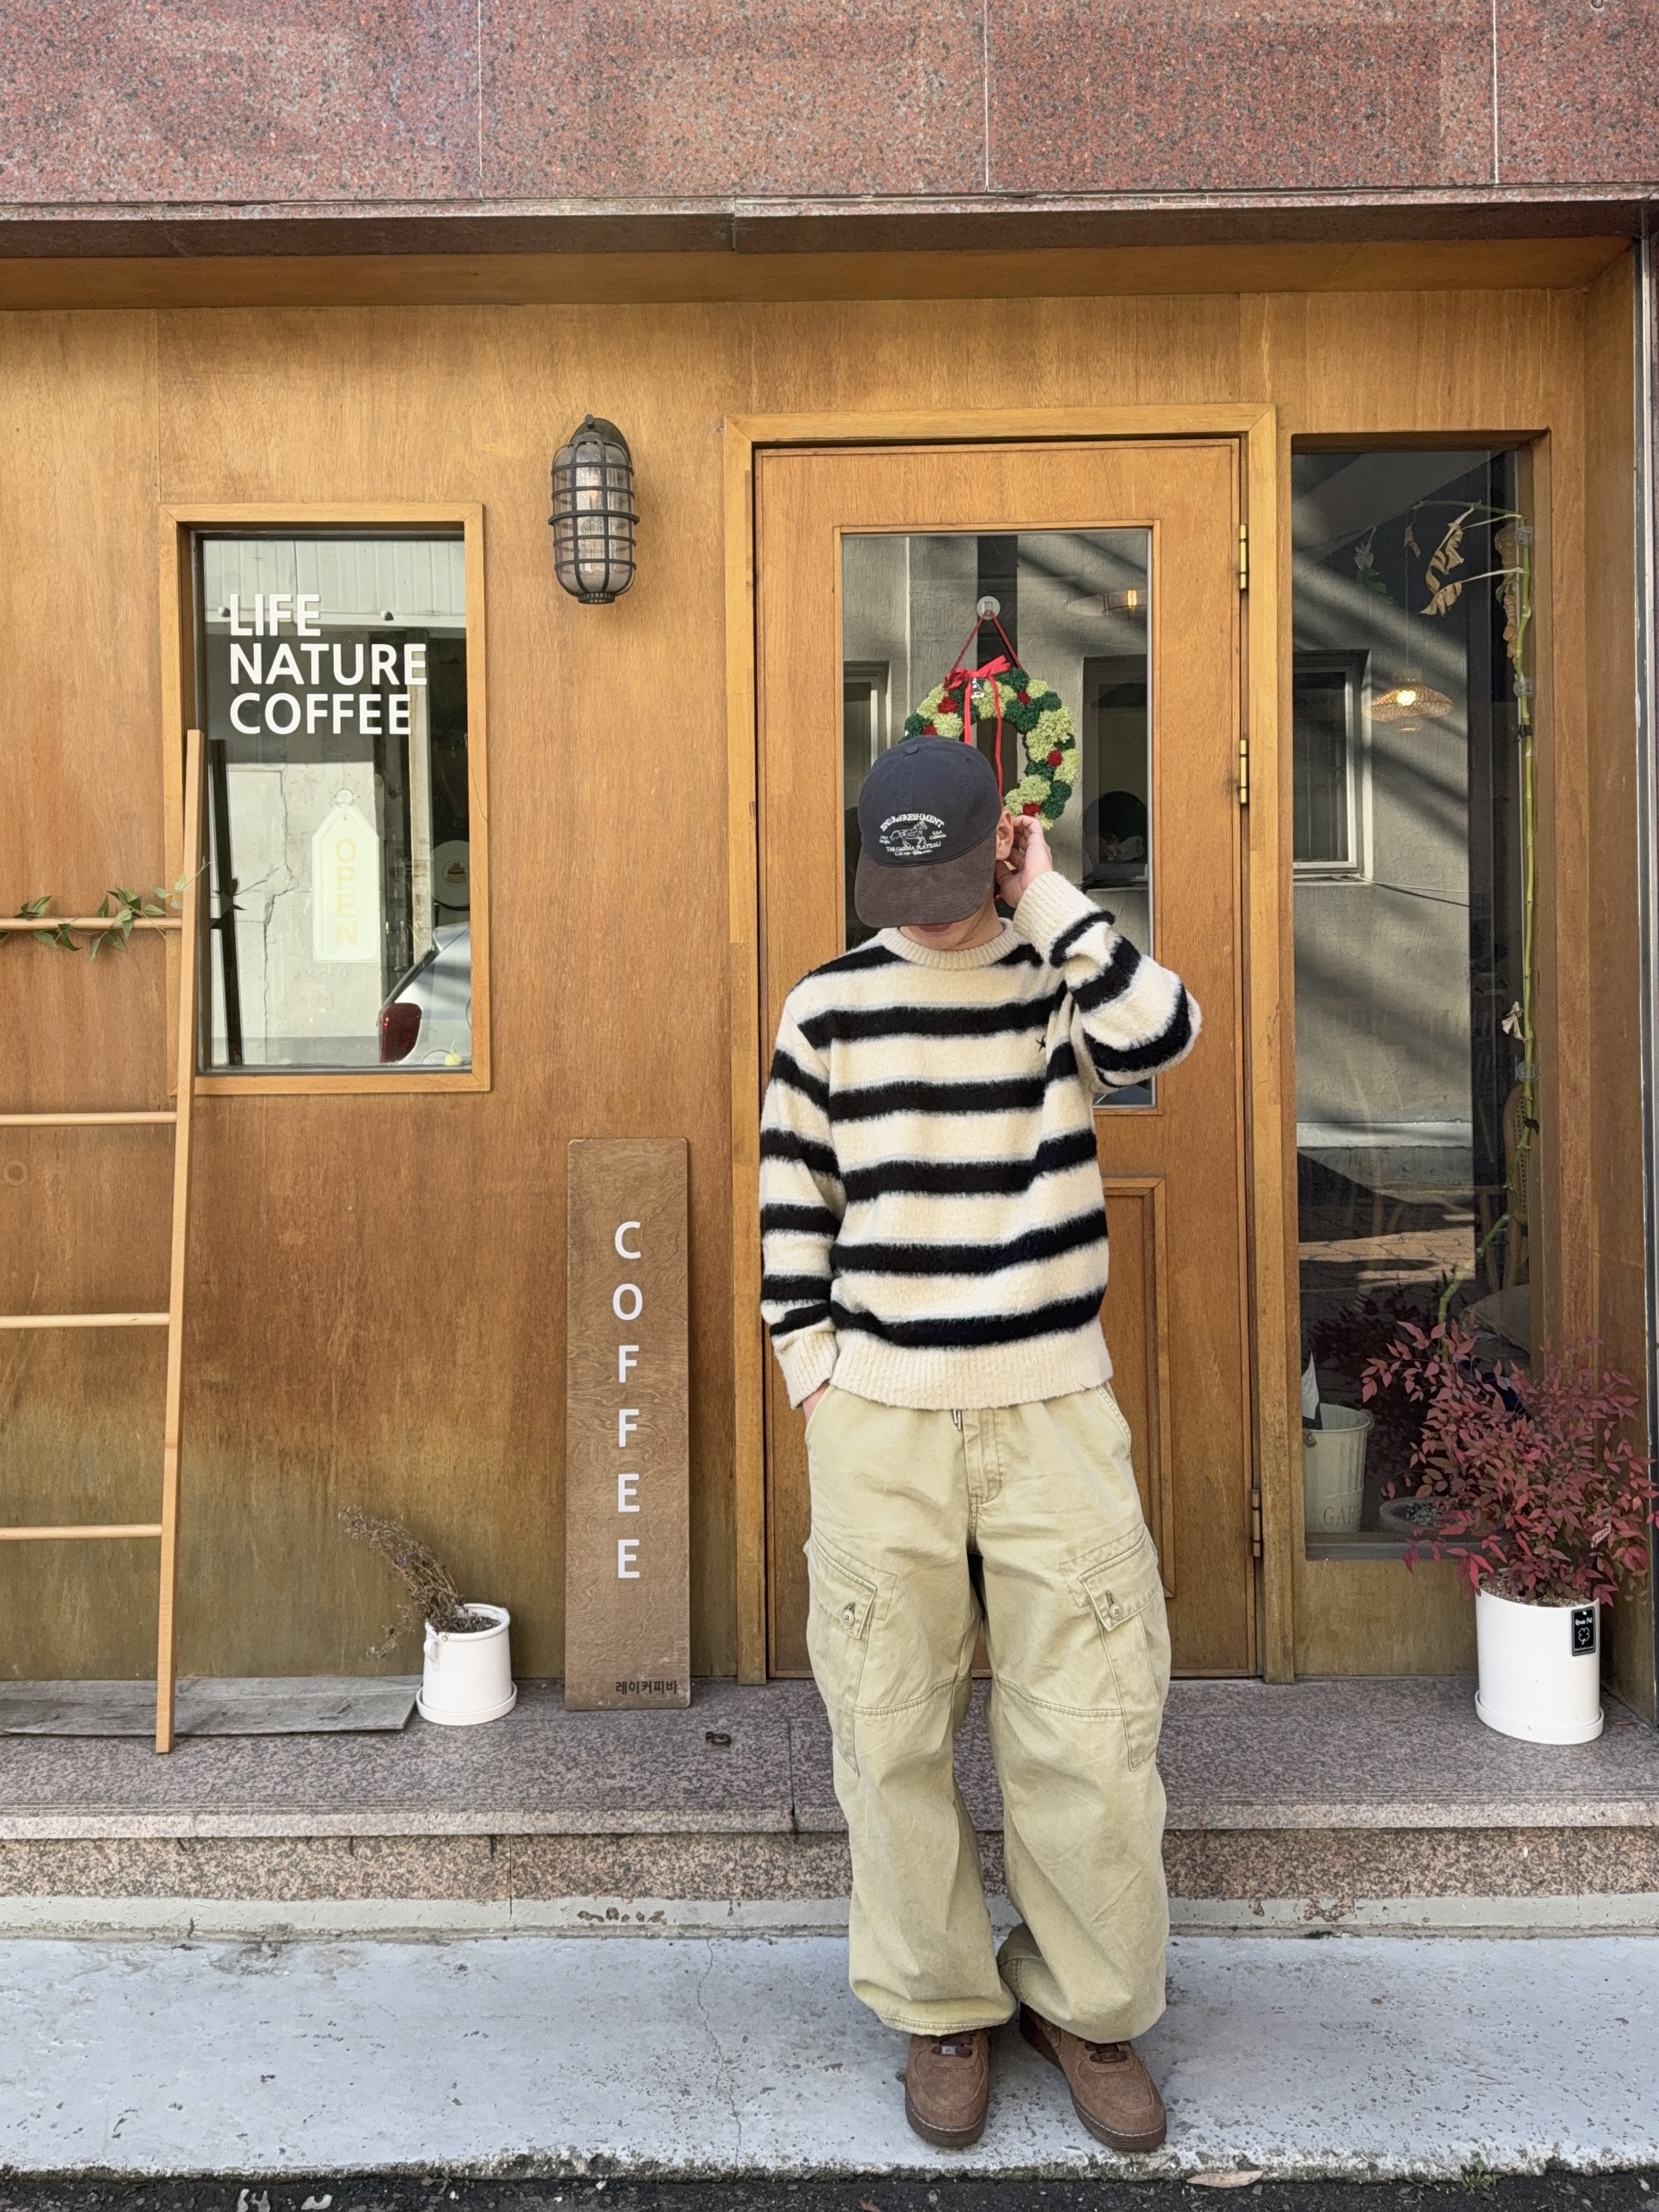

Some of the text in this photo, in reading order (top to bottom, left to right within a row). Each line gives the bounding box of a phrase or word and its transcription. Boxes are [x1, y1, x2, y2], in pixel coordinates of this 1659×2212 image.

[230, 594, 321, 636] LIFE
[230, 643, 427, 685] NATURE
[230, 692, 411, 735] COFFEE
[916, 841, 941, 850] PLATEAU
[335, 838, 357, 946] OPEN
[613, 1221, 643, 1579] COFFEE
[615, 1680, 678, 1695] 레이커피바
